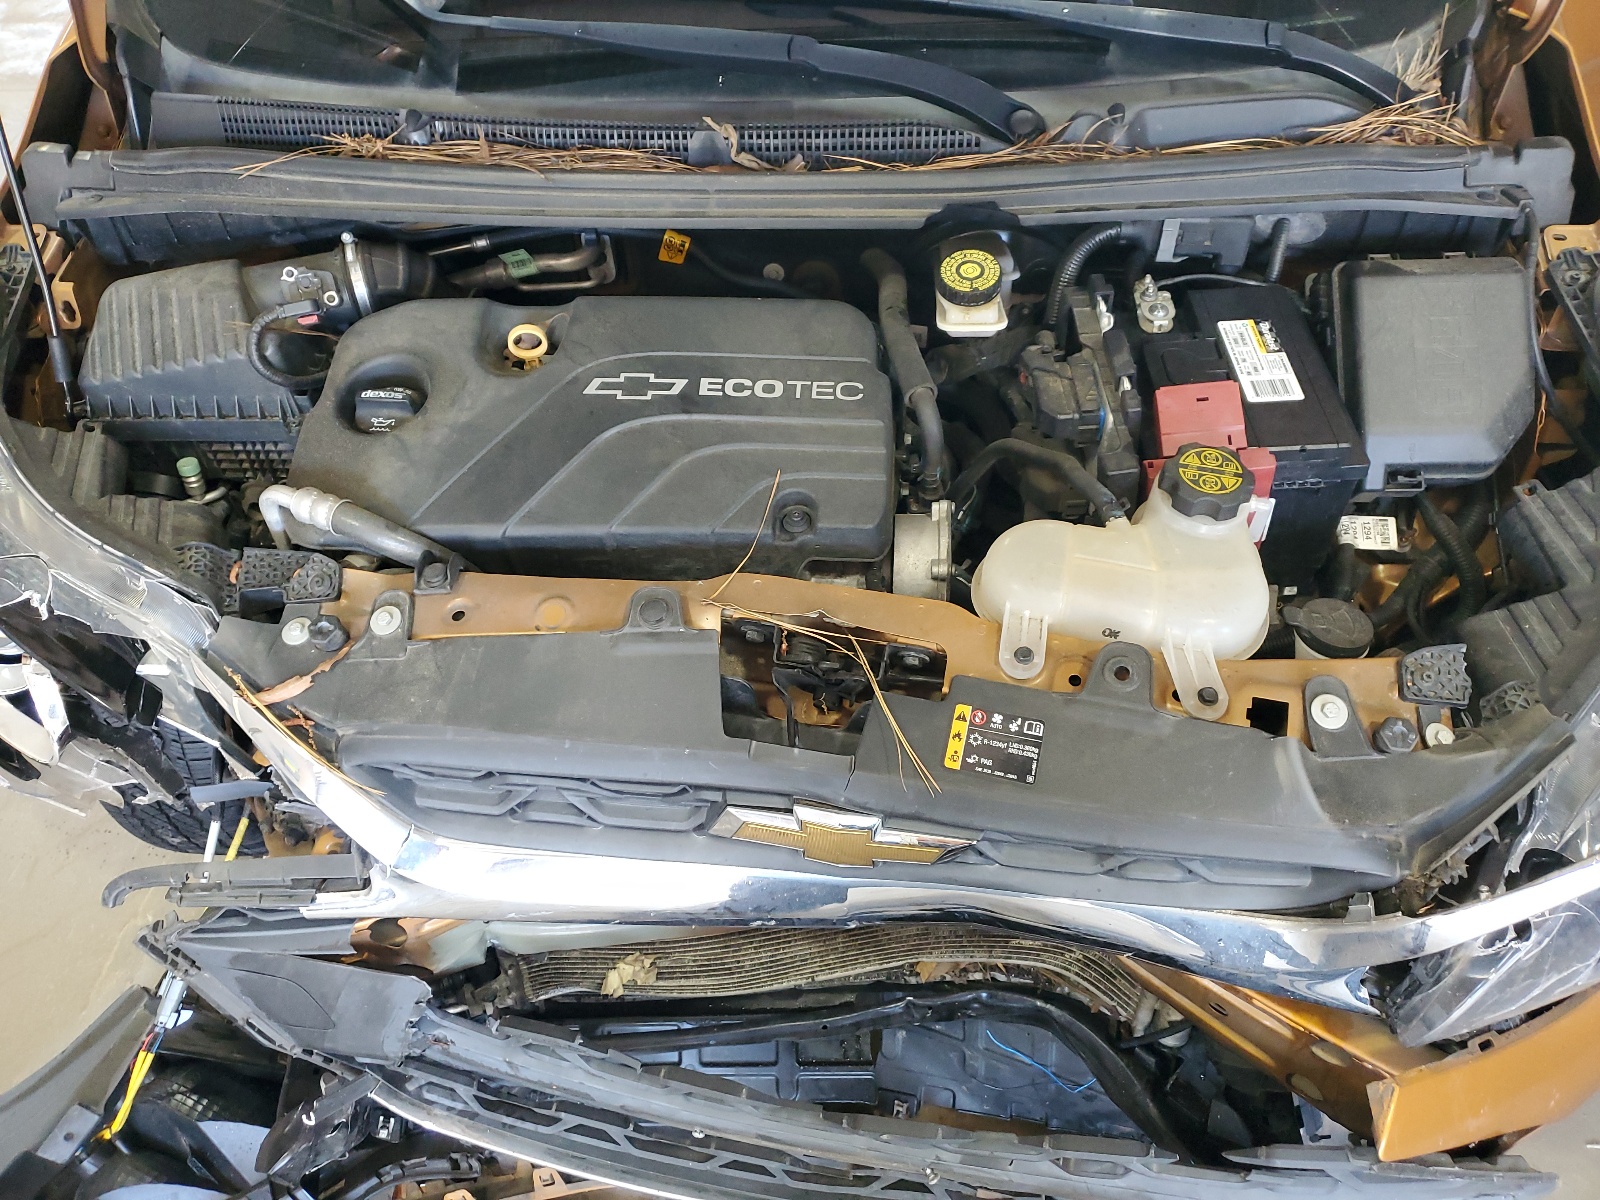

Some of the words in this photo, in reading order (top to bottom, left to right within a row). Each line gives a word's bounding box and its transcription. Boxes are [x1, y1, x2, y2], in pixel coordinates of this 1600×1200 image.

[361, 390, 406, 399] dexos
[698, 377, 864, 401] ECOTEC
[1363, 521, 1372, 540] 1294
[980, 758, 993, 766] PAG
